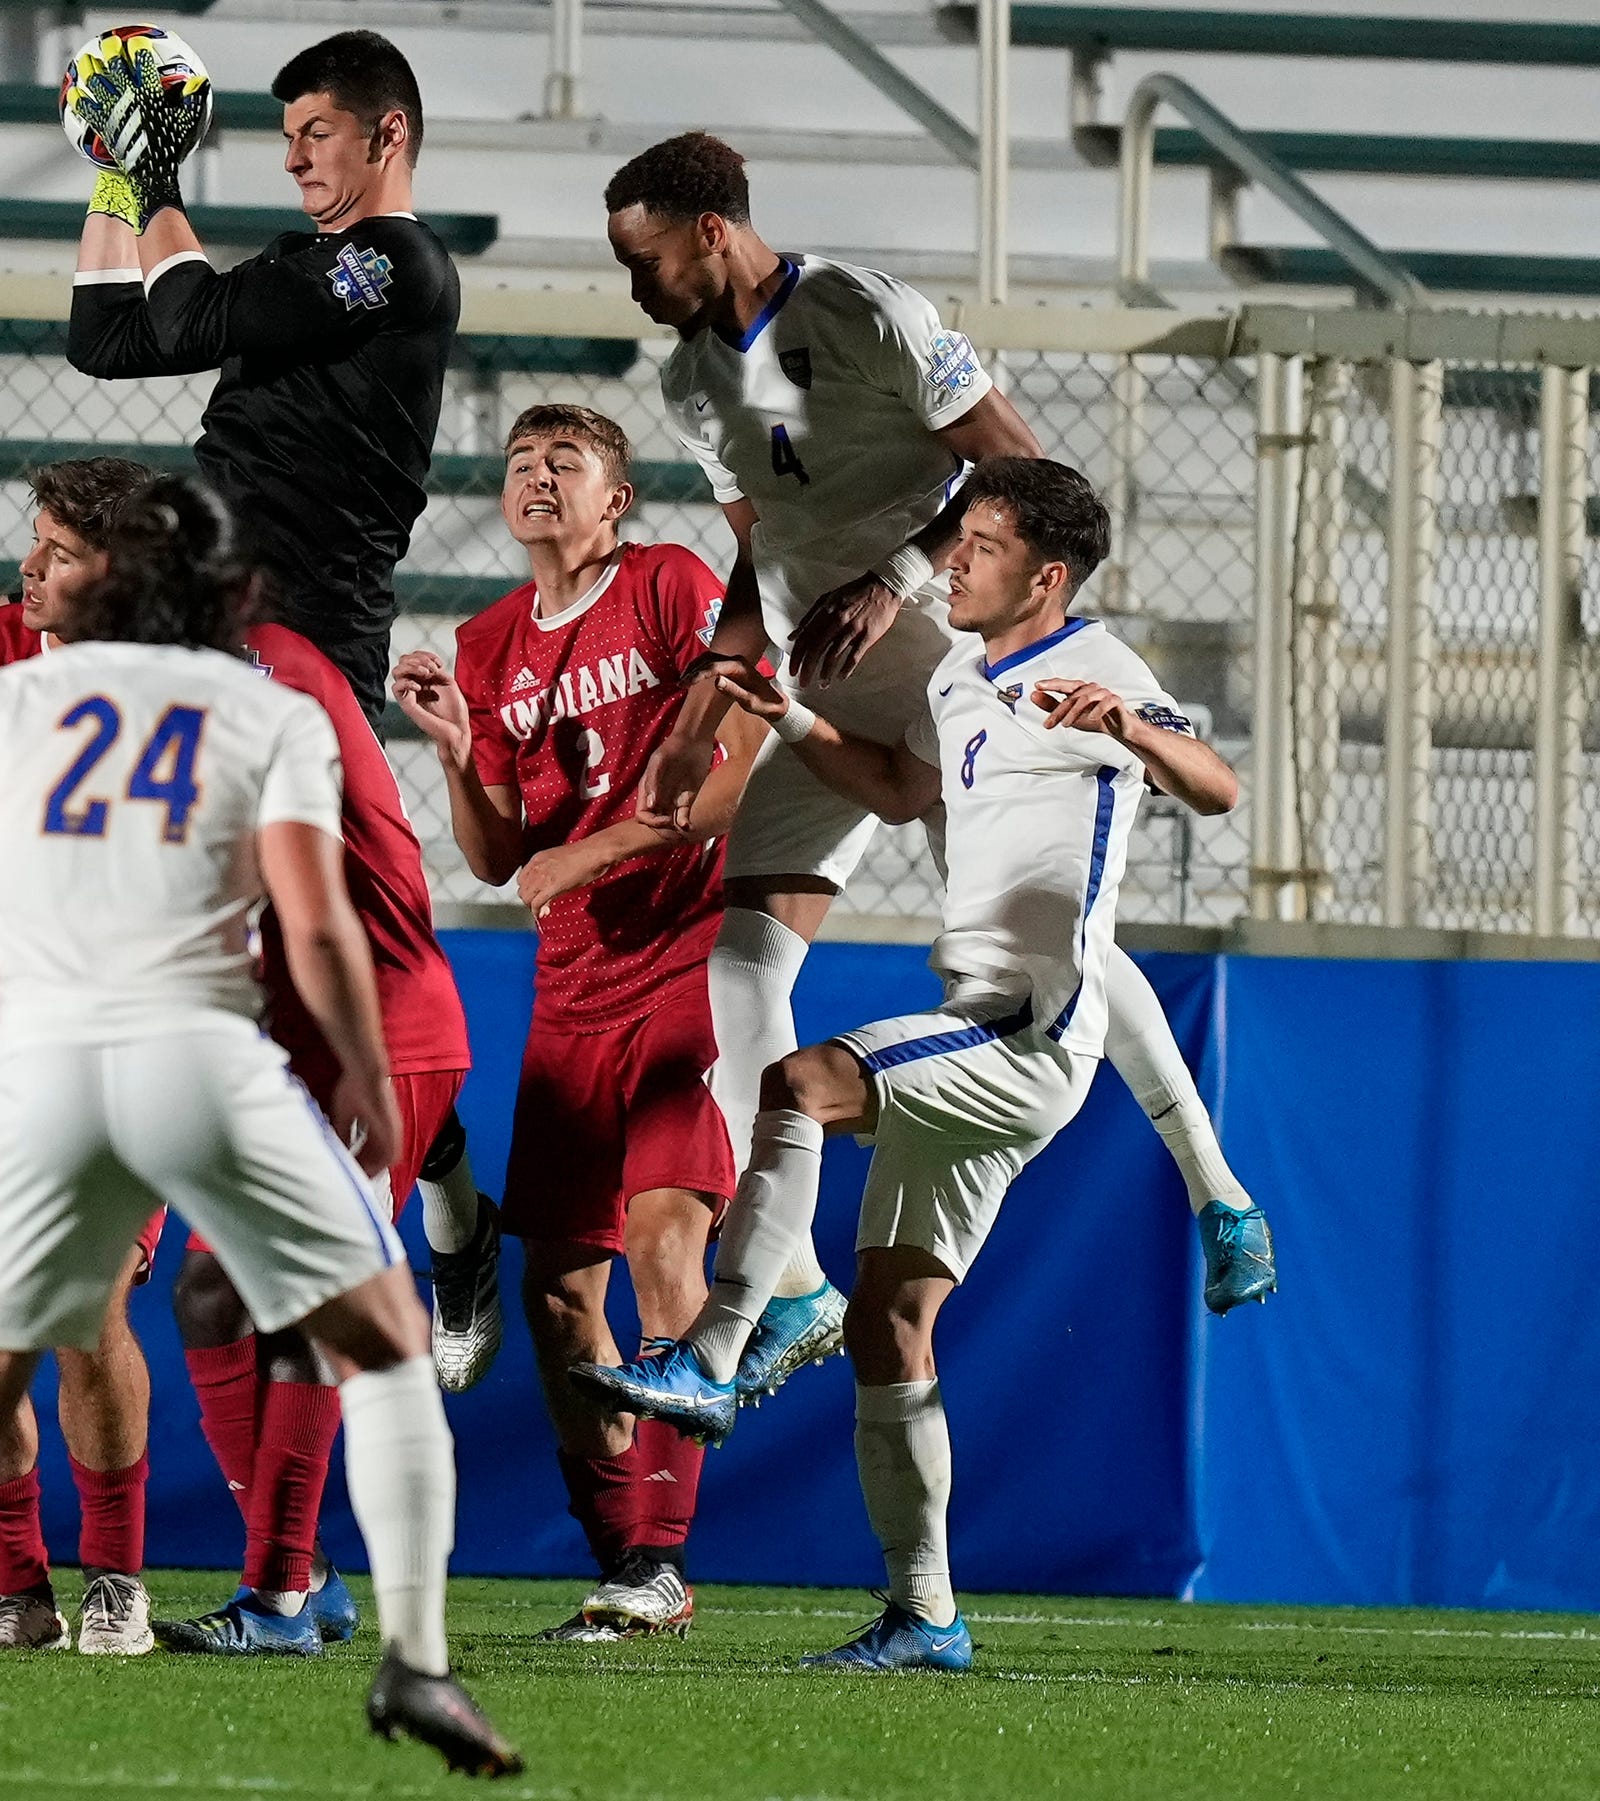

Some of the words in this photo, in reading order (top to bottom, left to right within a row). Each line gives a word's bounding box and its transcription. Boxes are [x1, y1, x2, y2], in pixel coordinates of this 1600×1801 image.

[343, 253, 369, 287] COLLEGE
[362, 286, 379, 303] CUP
[771, 422, 810, 486] 4
[500, 647, 661, 741] INDIANA
[510, 678, 542, 693] adidas
[41, 693, 208, 843] 24
[576, 727, 612, 799] 2
[960, 728, 988, 790] 8
